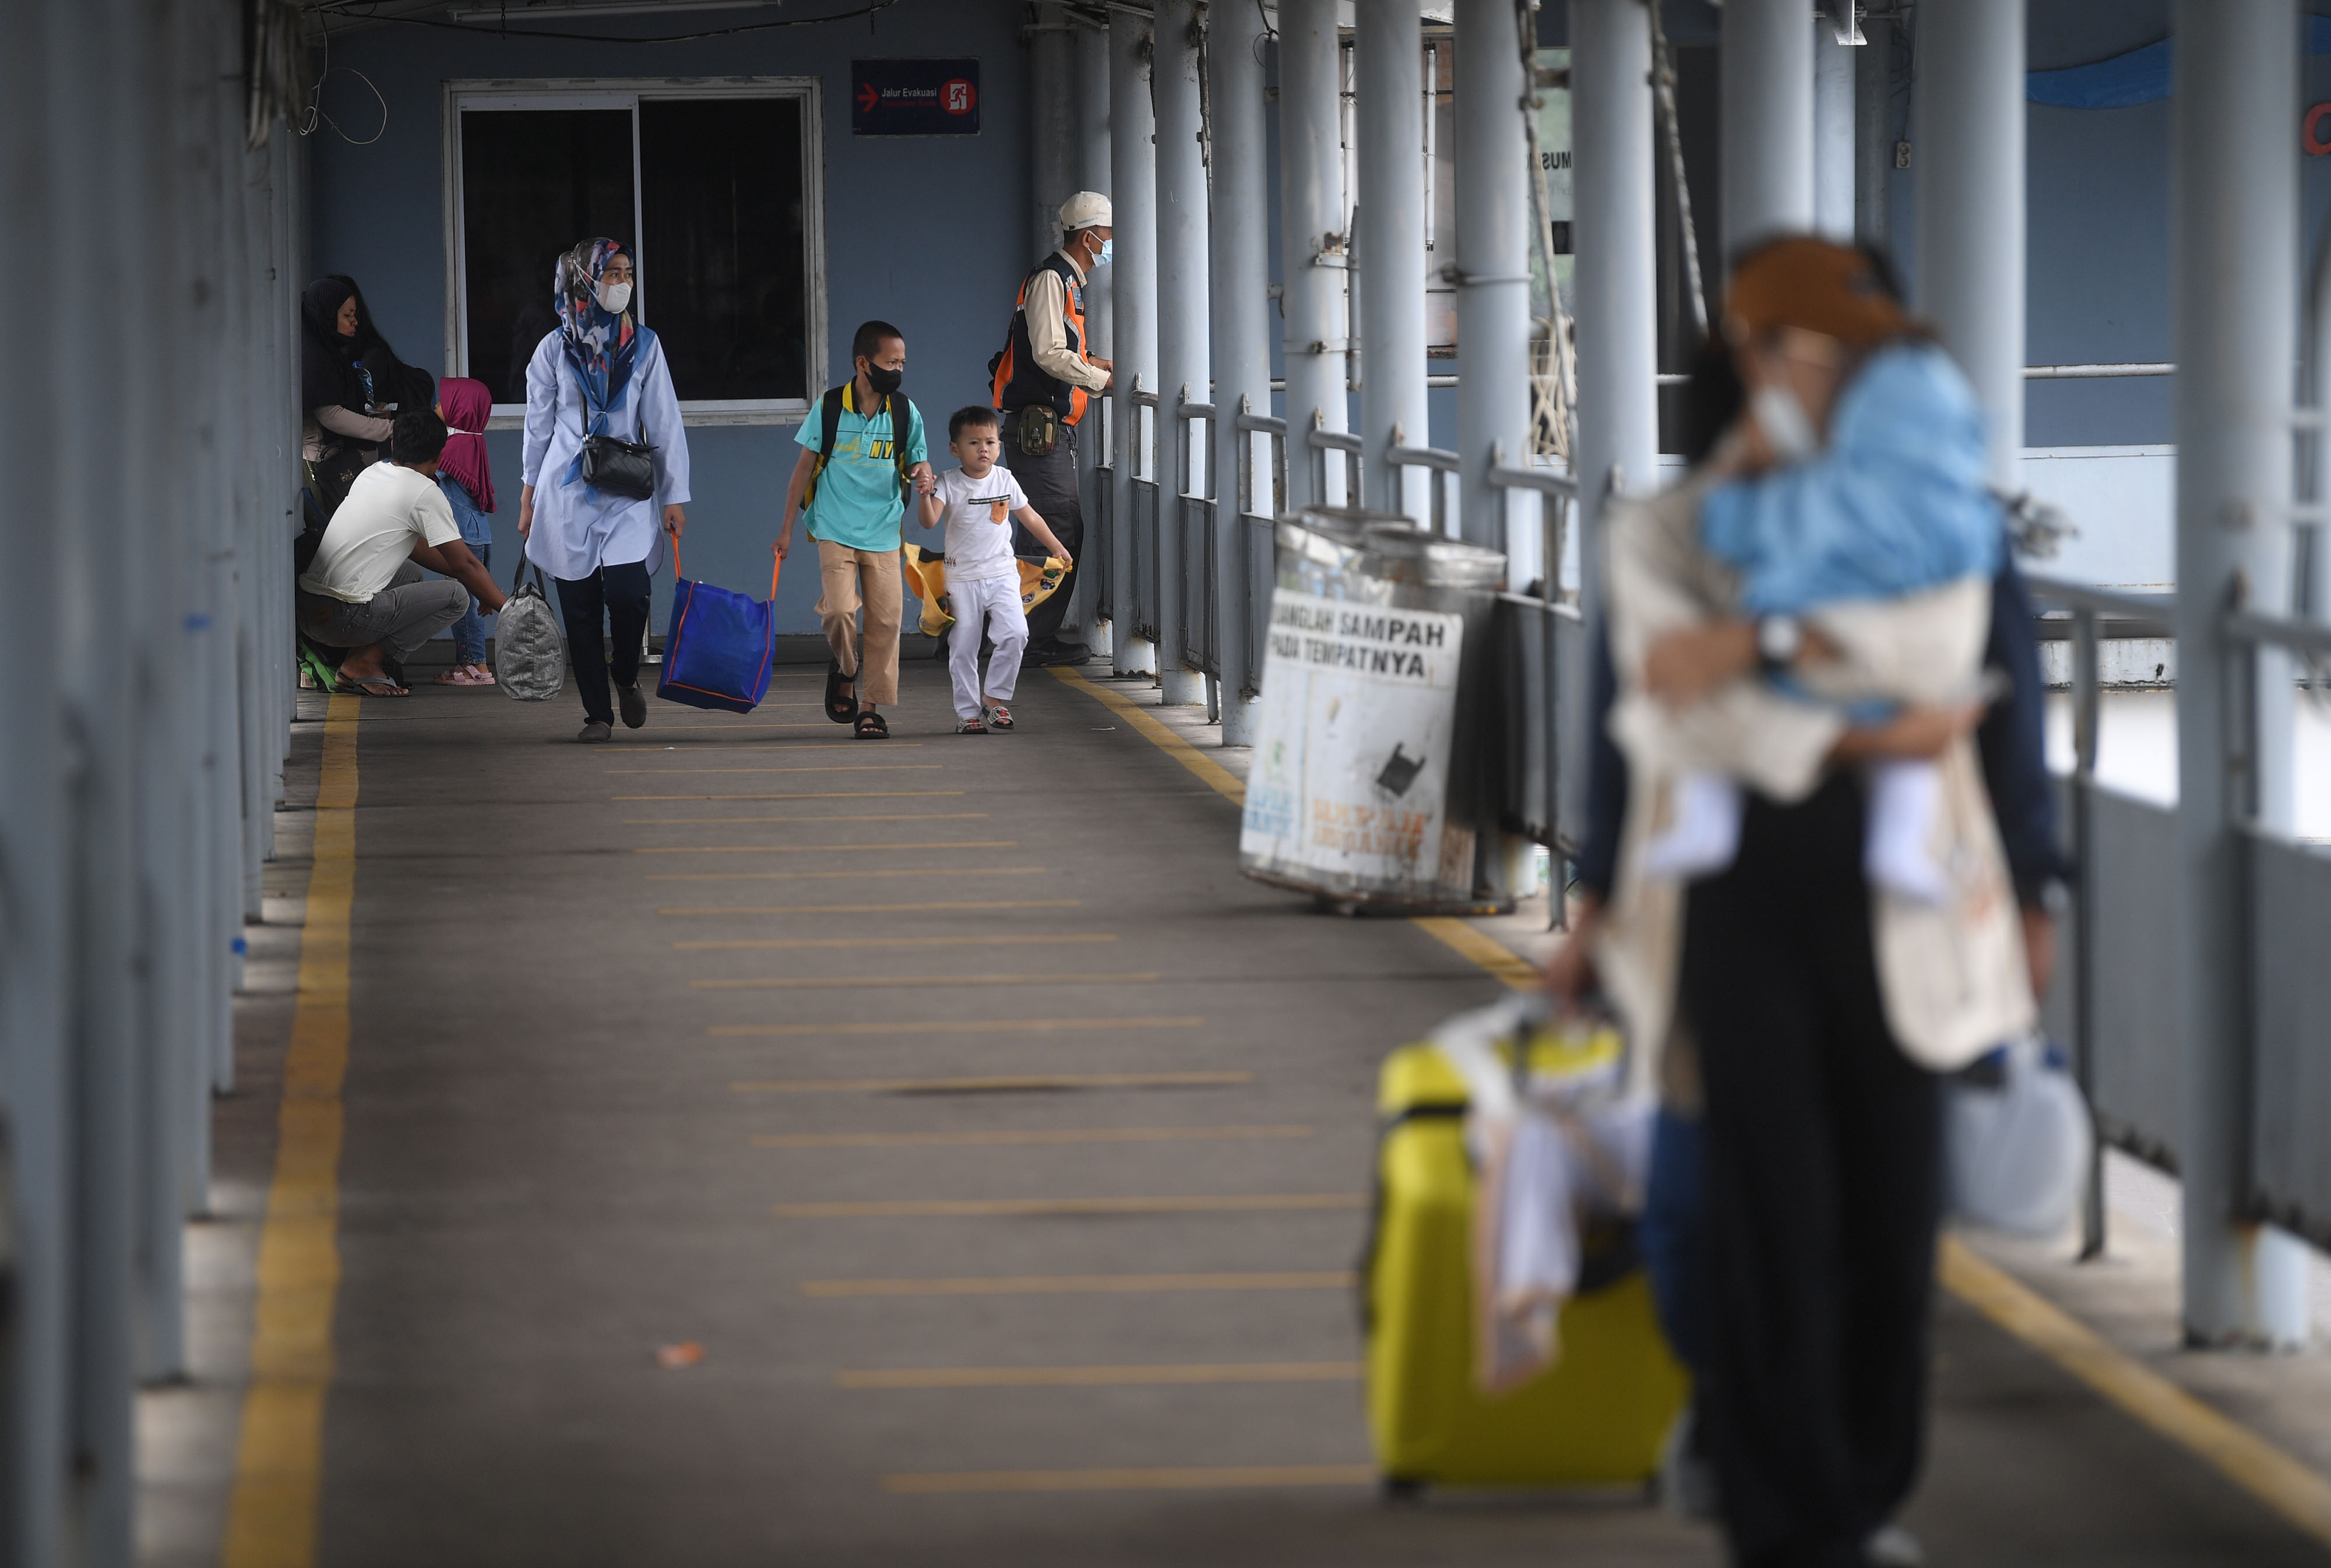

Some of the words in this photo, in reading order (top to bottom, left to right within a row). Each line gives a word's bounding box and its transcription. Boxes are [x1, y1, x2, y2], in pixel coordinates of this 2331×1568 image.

[882, 88, 902, 97] Jalur
[903, 87, 937, 97] Evakuasi
[868, 439, 895, 460] NY
[1340, 612, 1445, 647] SAMPAH
[1305, 638, 1425, 678] TEMPATNYA
